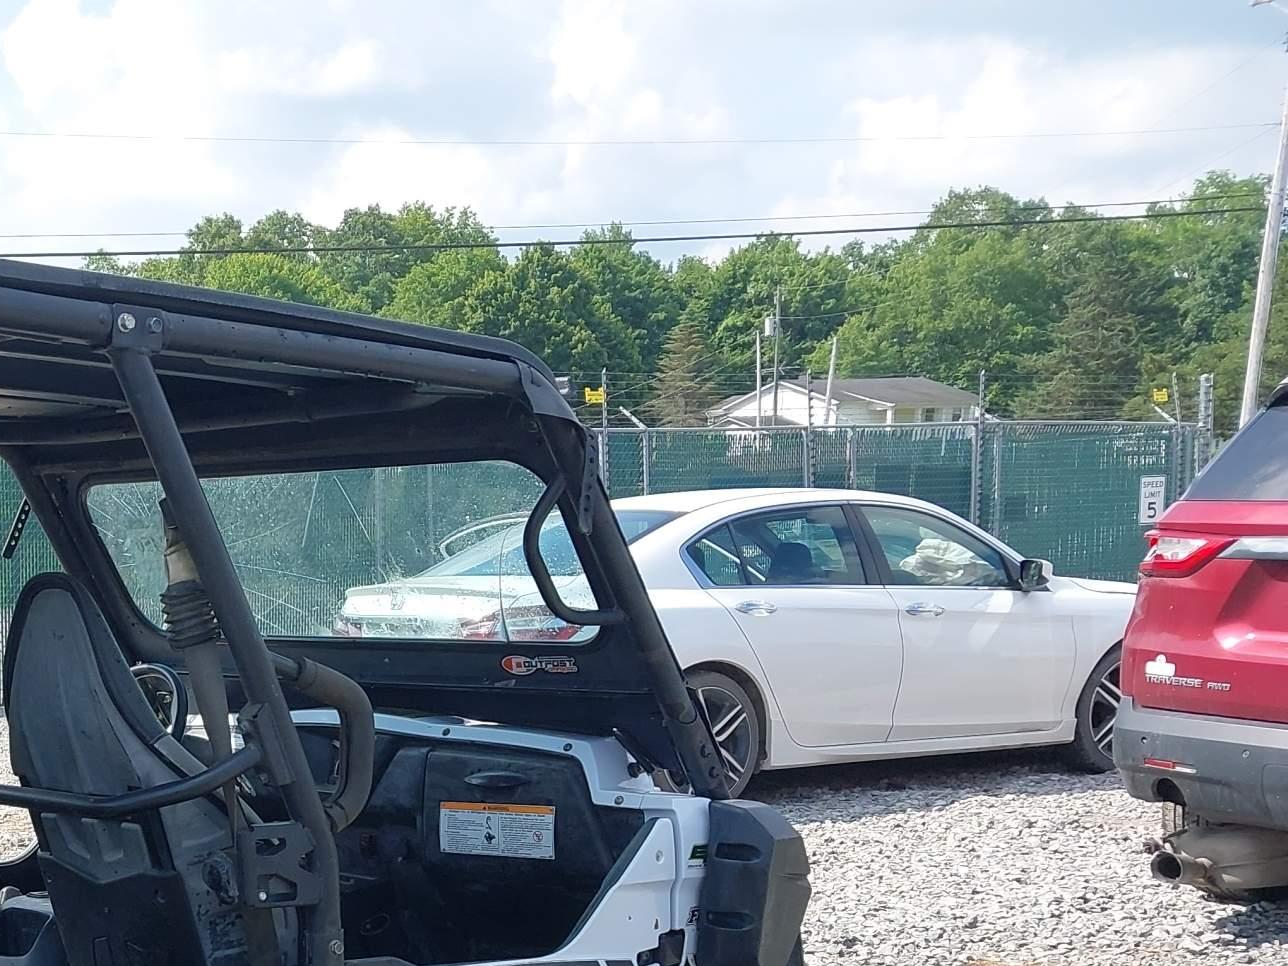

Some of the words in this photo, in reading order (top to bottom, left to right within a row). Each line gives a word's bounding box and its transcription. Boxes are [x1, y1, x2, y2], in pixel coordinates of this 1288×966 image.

[1147, 502, 1157, 518] 5
[1145, 674, 1203, 688] TRAVERSE
[1207, 681, 1231, 691] AWD
